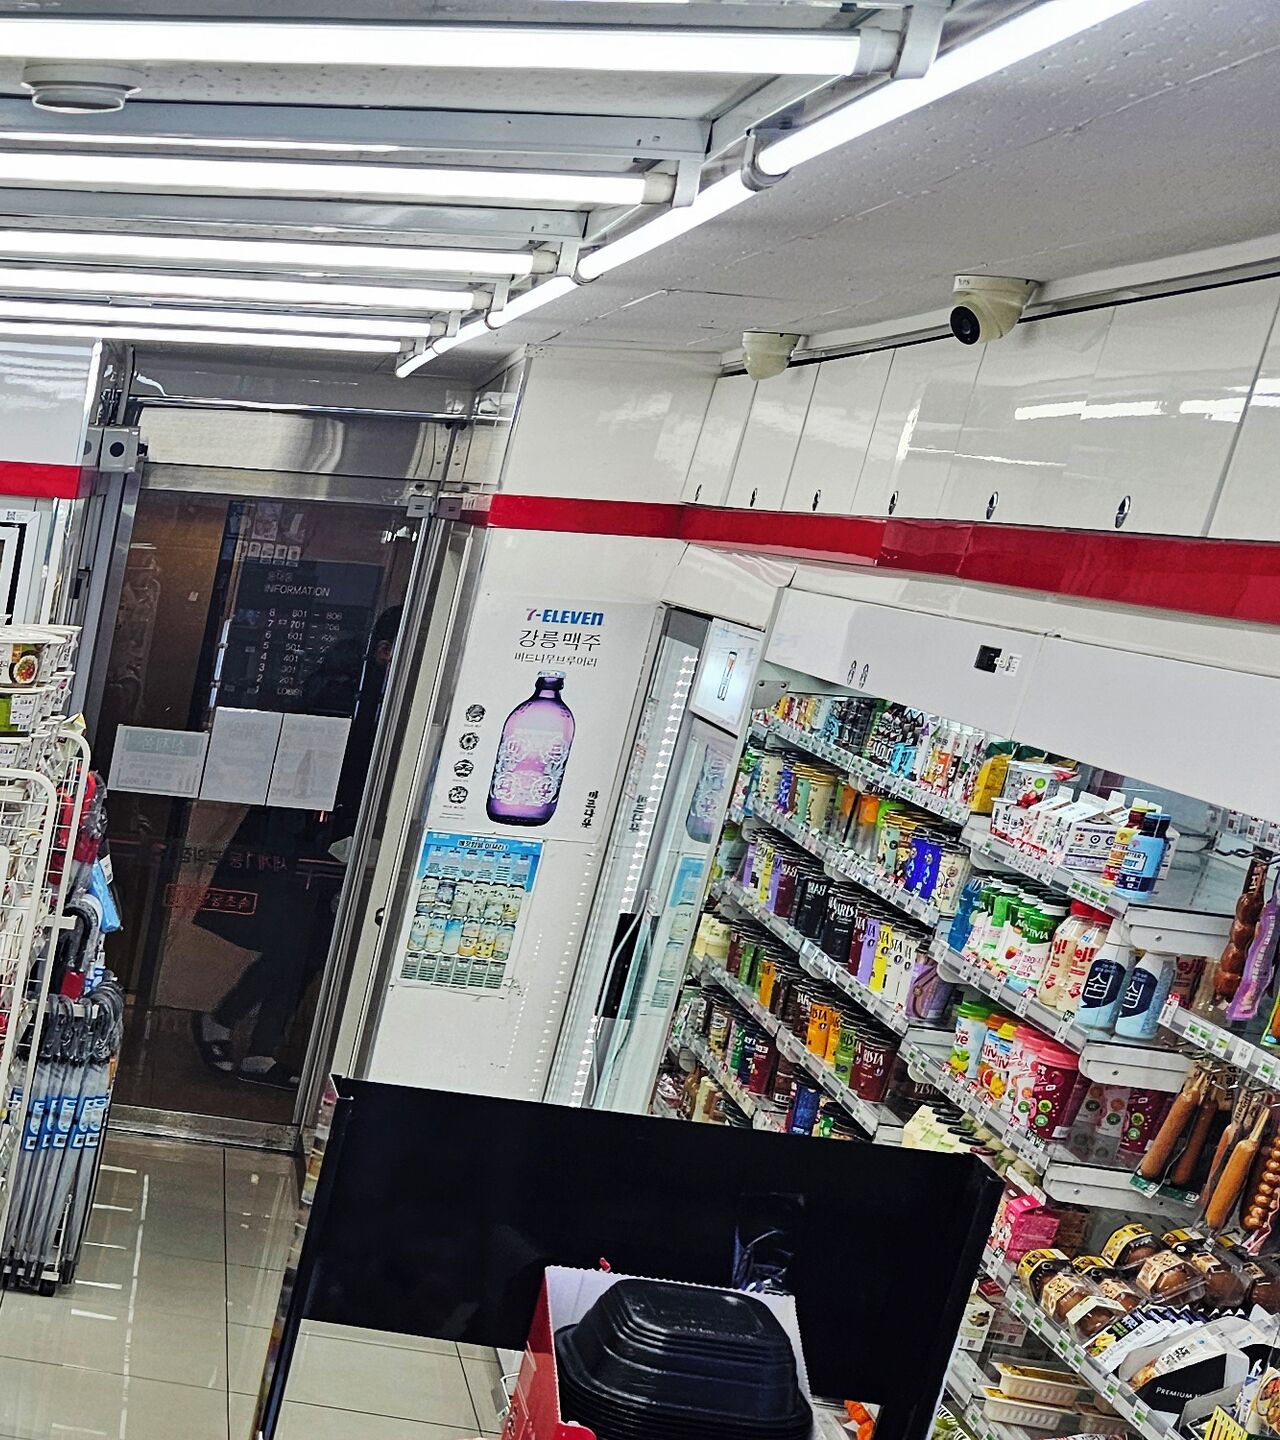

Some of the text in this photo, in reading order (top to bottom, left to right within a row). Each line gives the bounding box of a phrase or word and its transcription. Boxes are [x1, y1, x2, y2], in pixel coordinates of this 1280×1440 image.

[264, 584, 330, 597] INFORMATION
[519, 628, 601, 653] 강릉맥주
[1155, 1386, 1193, 1400] PREMIUM
